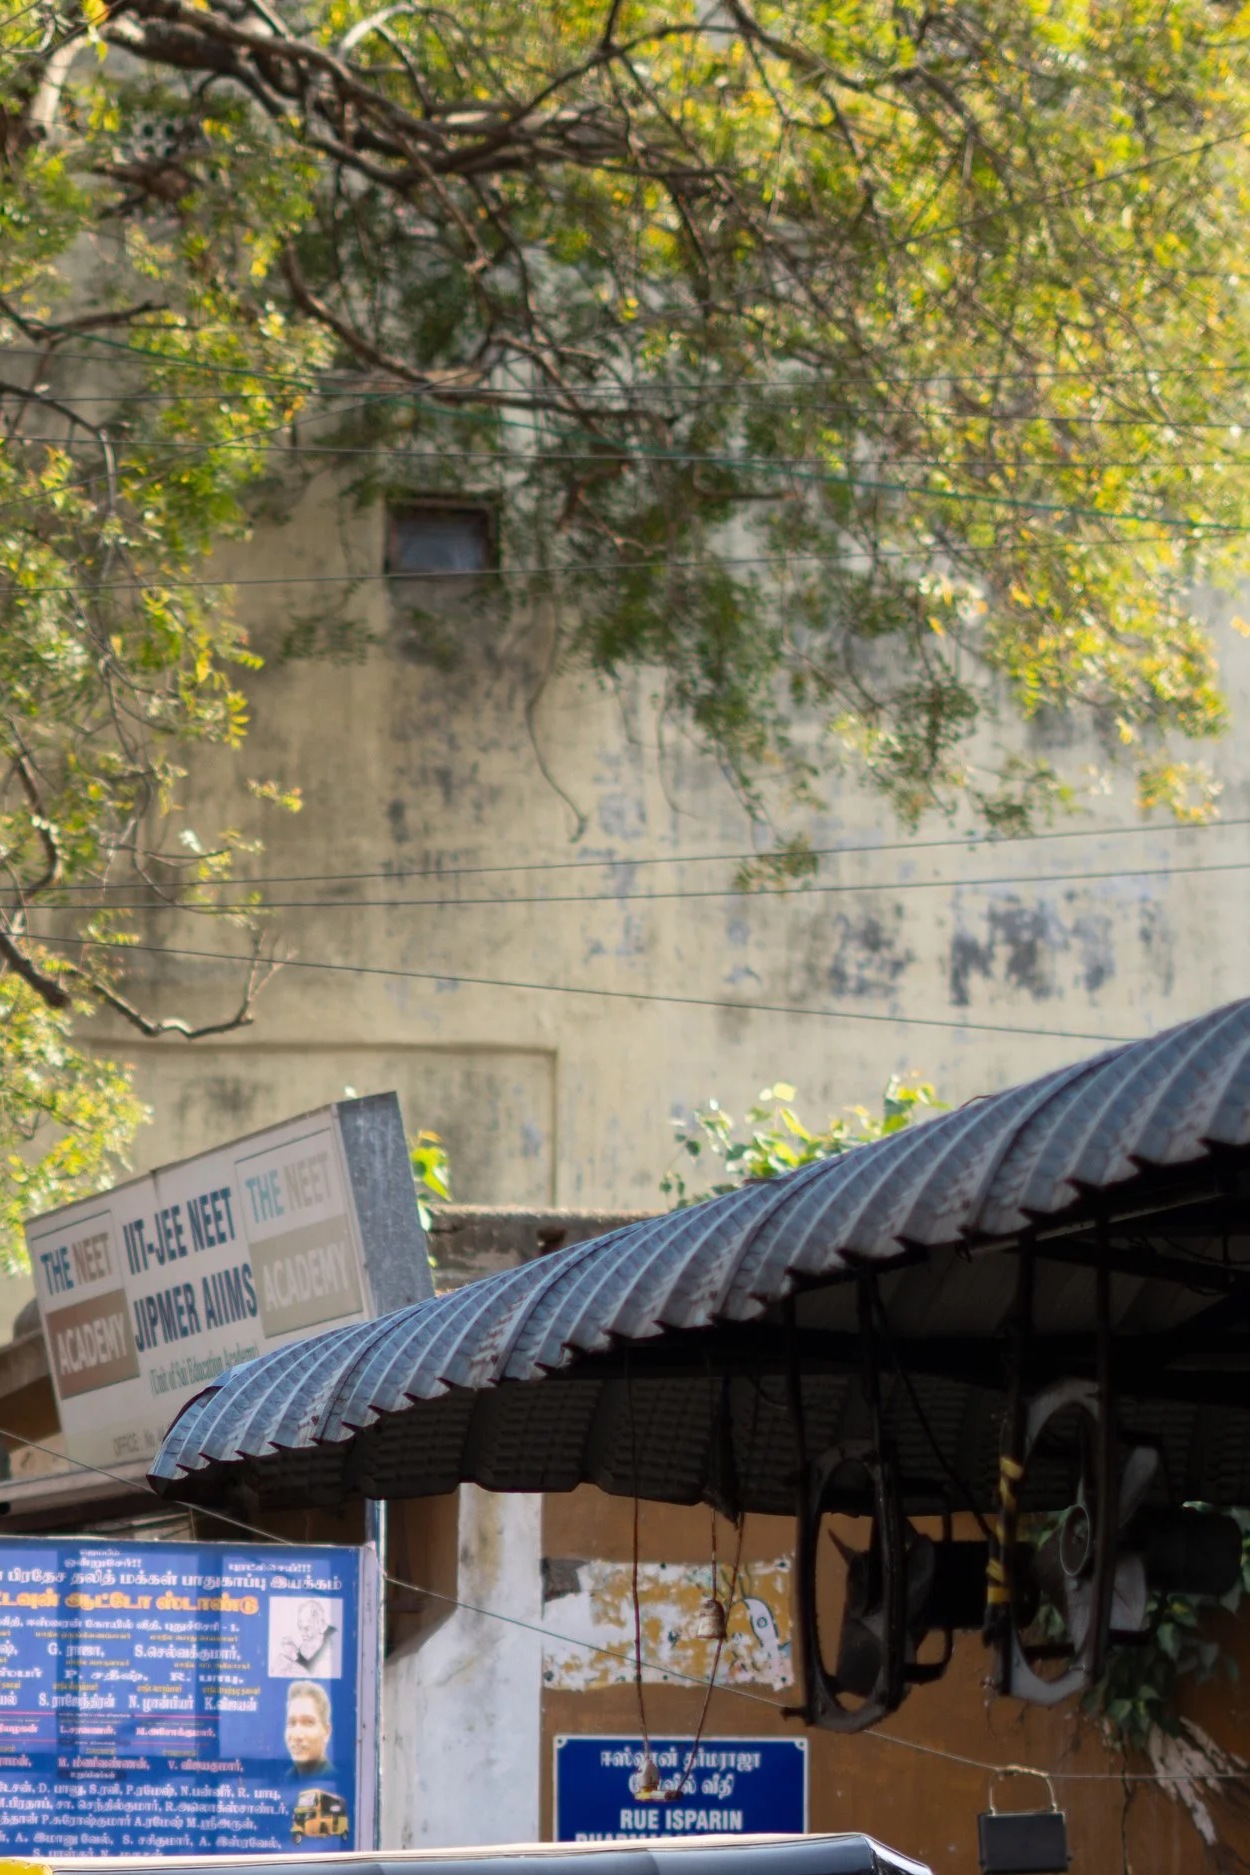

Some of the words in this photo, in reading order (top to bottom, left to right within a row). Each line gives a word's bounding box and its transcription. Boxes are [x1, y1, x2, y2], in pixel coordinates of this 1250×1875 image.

[245, 1170, 285, 1223] THE
[284, 1151, 333, 1212] NEET
[123, 1204, 188, 1275] IIT-JEE
[187, 1186, 236, 1253] NEET
[40, 1247, 74, 1296] THE
[71, 1232, 112, 1286] NEET
[262, 1246, 350, 1312] ACADEMY
[133, 1282, 200, 1352] JIPMER
[204, 1263, 258, 1330] AIIMS
[57, 1312, 128, 1376] ACADEMY
[8, 1567, 66, 1584] பிரதேச
[69, 1568, 116, 1586] தலித்
[120, 1570, 177, 1587] மக்கள்
[182, 1571, 266, 1591] பாதுகாப்பு
[271, 1574, 342, 1590] இயக்கம்
[702, 1773, 735, 1799] வீதி
[620, 1808, 659, 1829] RUE
[665, 1809, 743, 1830] ISPARIN
